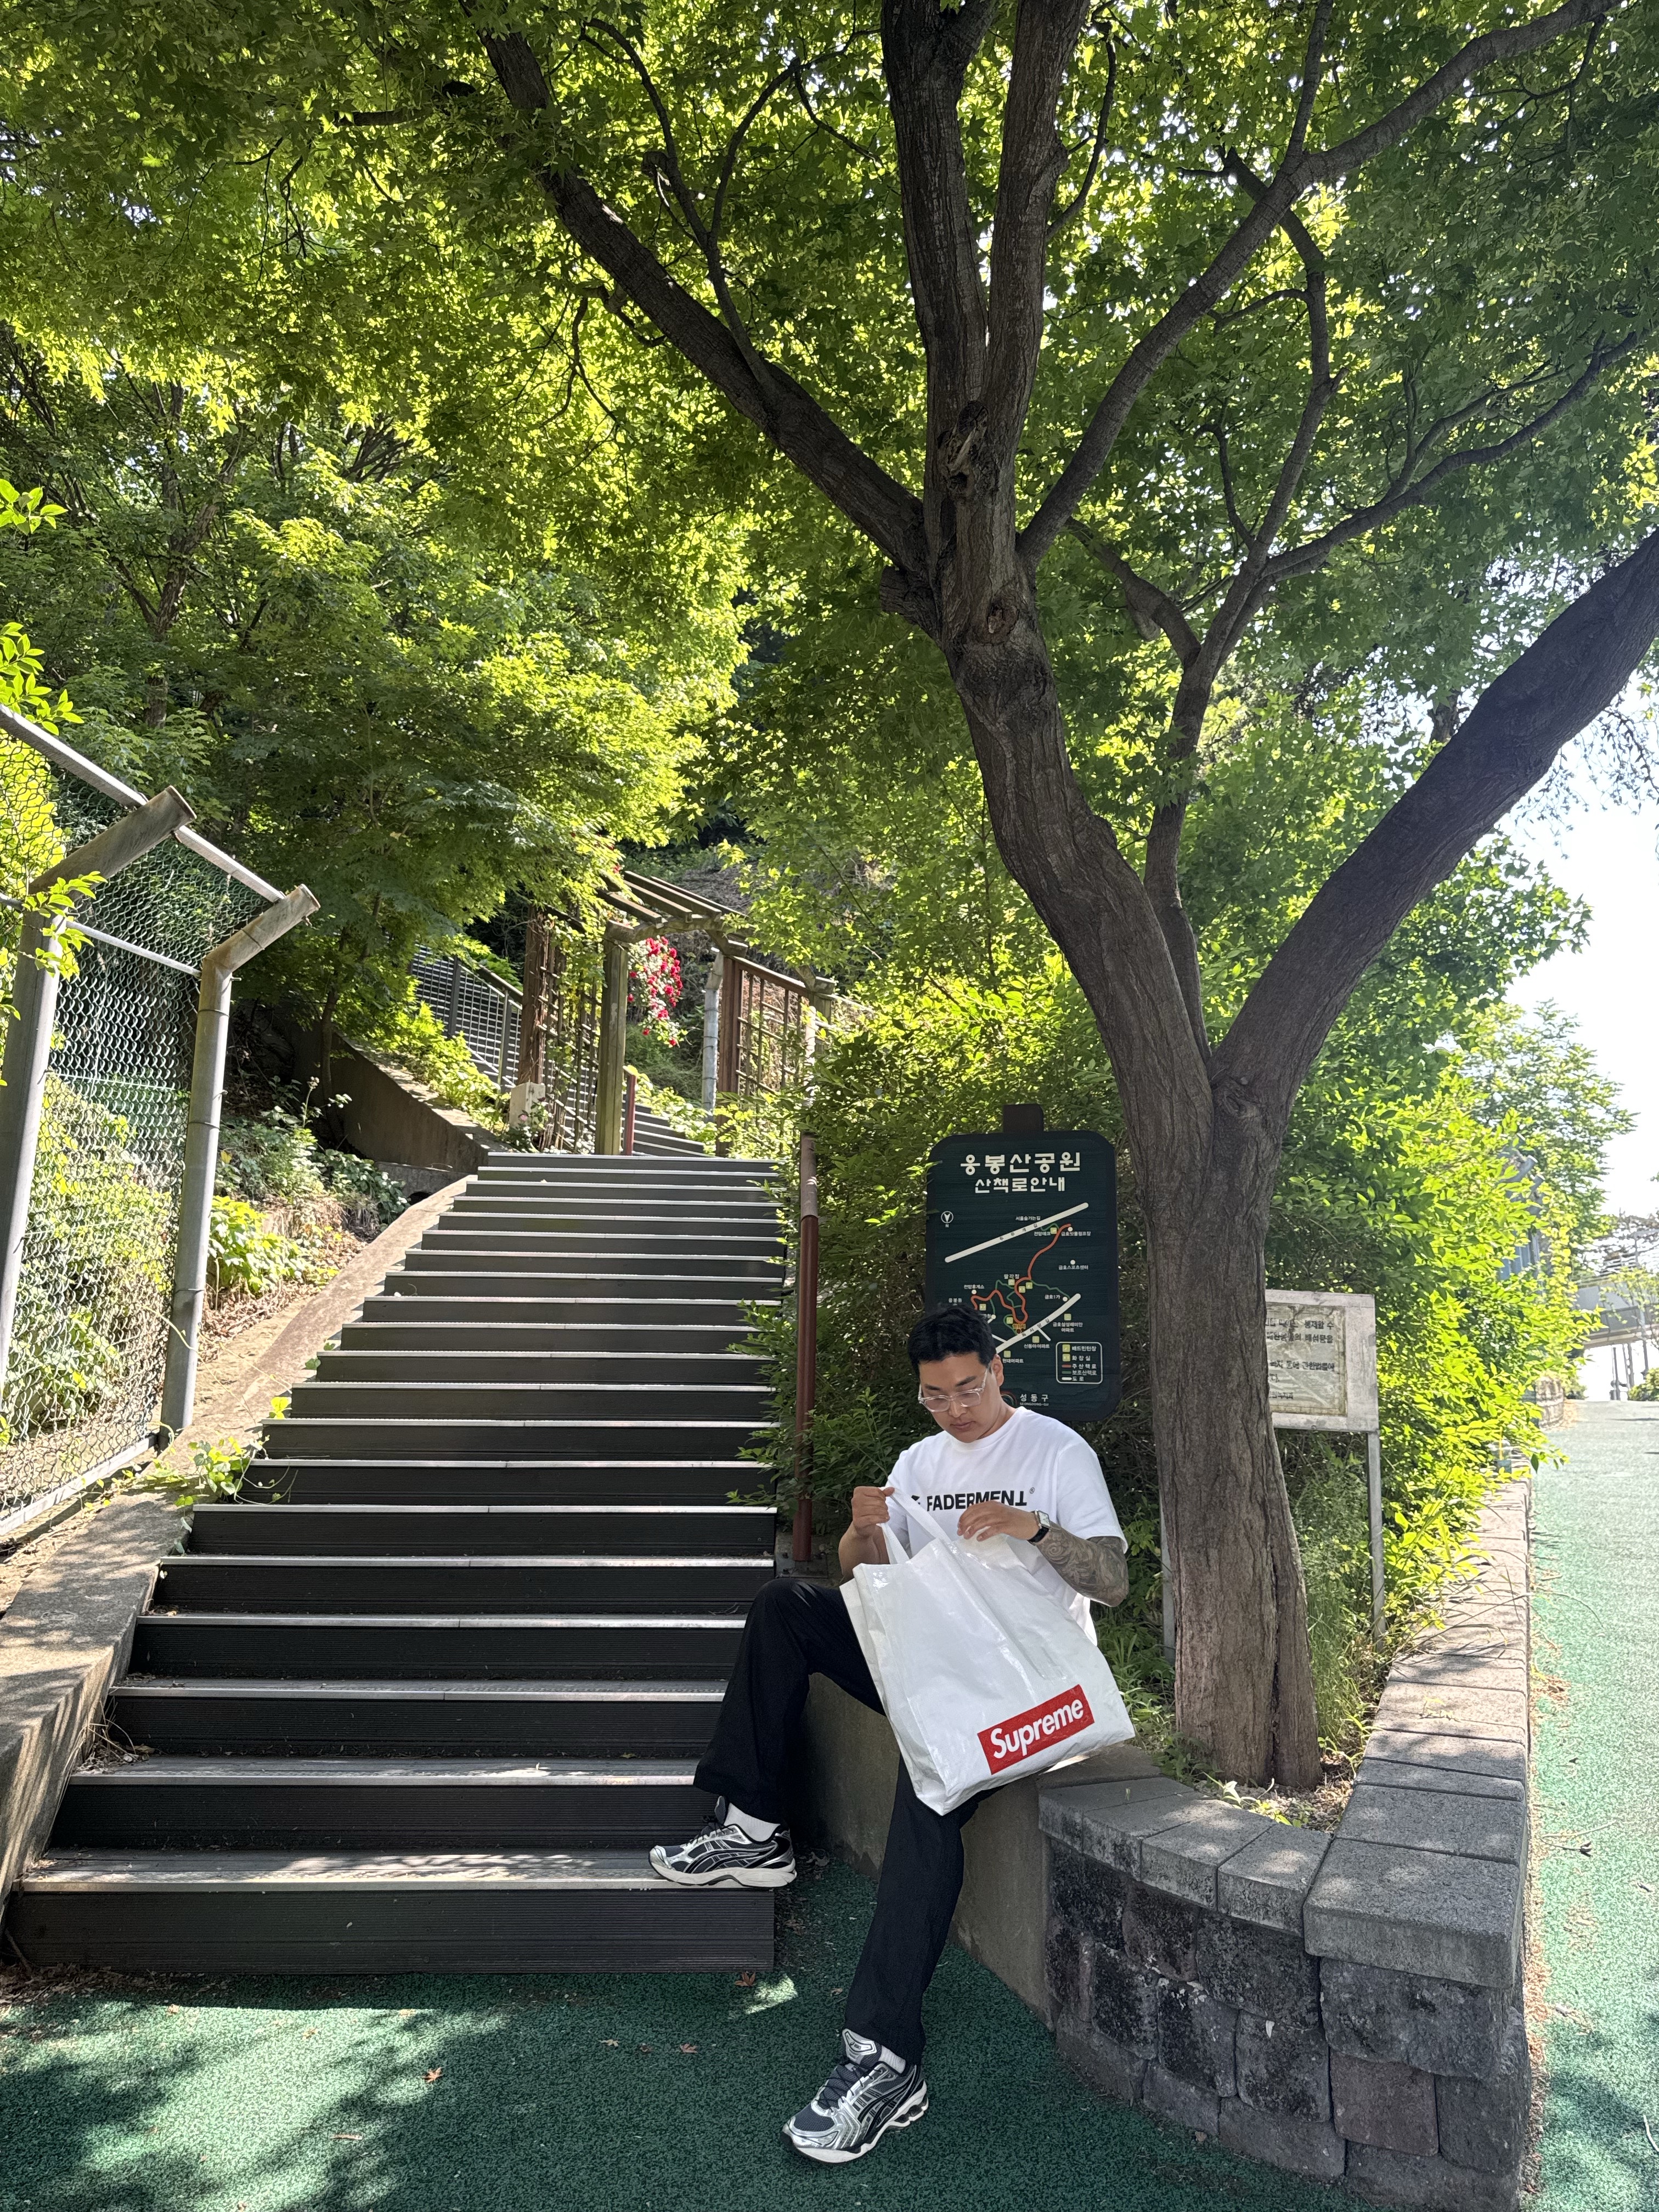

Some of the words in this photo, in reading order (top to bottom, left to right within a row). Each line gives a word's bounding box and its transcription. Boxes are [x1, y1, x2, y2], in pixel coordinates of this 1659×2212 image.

[960, 1152, 1080, 1176] 응봉산공원
[975, 1177, 1065, 1193] 산책로안내
[1327, 1321, 1334, 1330] 수
[1020, 1393, 1049, 1402] 성동구
[990, 1699, 1084, 1759] Supreme
